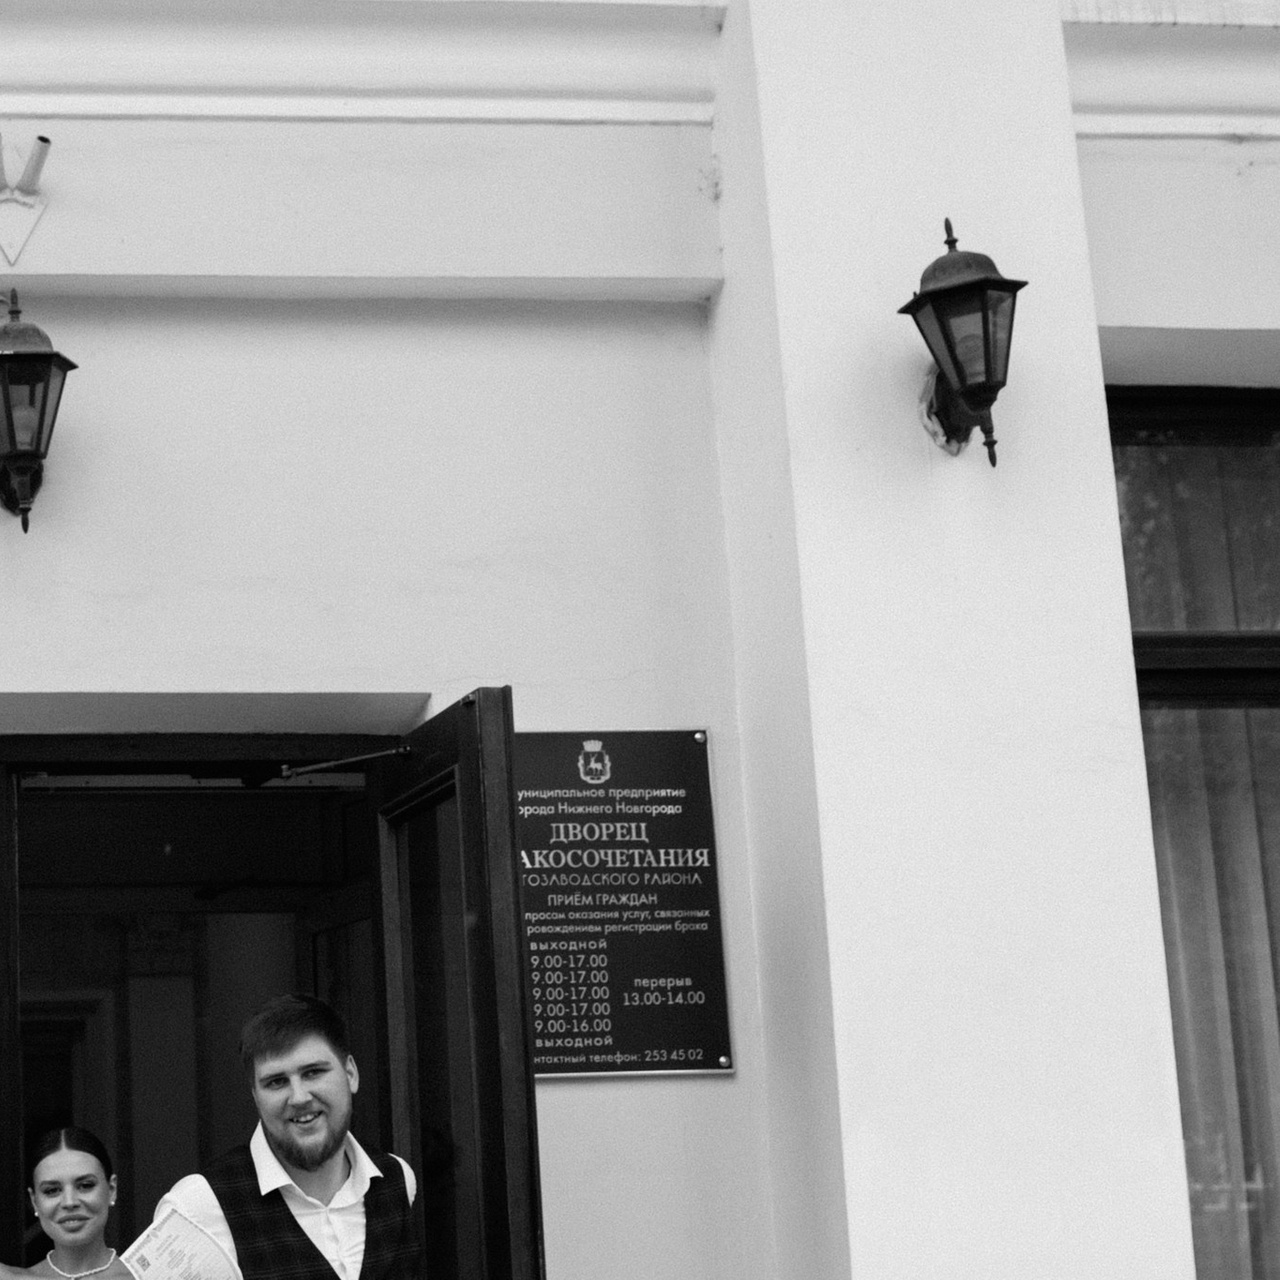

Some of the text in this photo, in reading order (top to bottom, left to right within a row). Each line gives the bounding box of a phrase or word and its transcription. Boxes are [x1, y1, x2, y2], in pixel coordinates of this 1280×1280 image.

[518, 788, 686, 801] униципальное предприятие
[558, 802, 613, 814] Нижнего
[616, 802, 682, 817] Новгорода
[550, 823, 649, 844] ДВОРЕЦ
[521, 848, 710, 868] АКОСОЧЕТАНИЯ
[644, 872, 702, 885] РАЙОНА
[548, 892, 657, 907] ПРИЁМ ГРАЖДАН
[525, 912, 566, 923] просам
[622, 911, 651, 921] услуг,
[654, 910, 710, 918] связанных
[605, 924, 672, 934] регистрации
[675, 920, 708, 933] брака
[530, 939, 607, 950] выходной
[531, 955, 607, 968] 9.00-17.00
[532, 971, 608, 984] 9.00-17.00
[634, 978, 692, 990] перерыв
[533, 987, 609, 1000] 9.00-17.00
[623, 991, 705, 1006] 13.00-14.00
[534, 1003, 610, 1017] 9.00-17.00
[535, 1019, 611, 1033] 9.00-16.00
[536, 1035, 613, 1048] выходной
[589, 1051, 641, 1064] телефон:
[645, 1050, 667, 1062] 253
[671, 1050, 684, 1060] 45
[688, 1049, 703, 1060] 02
